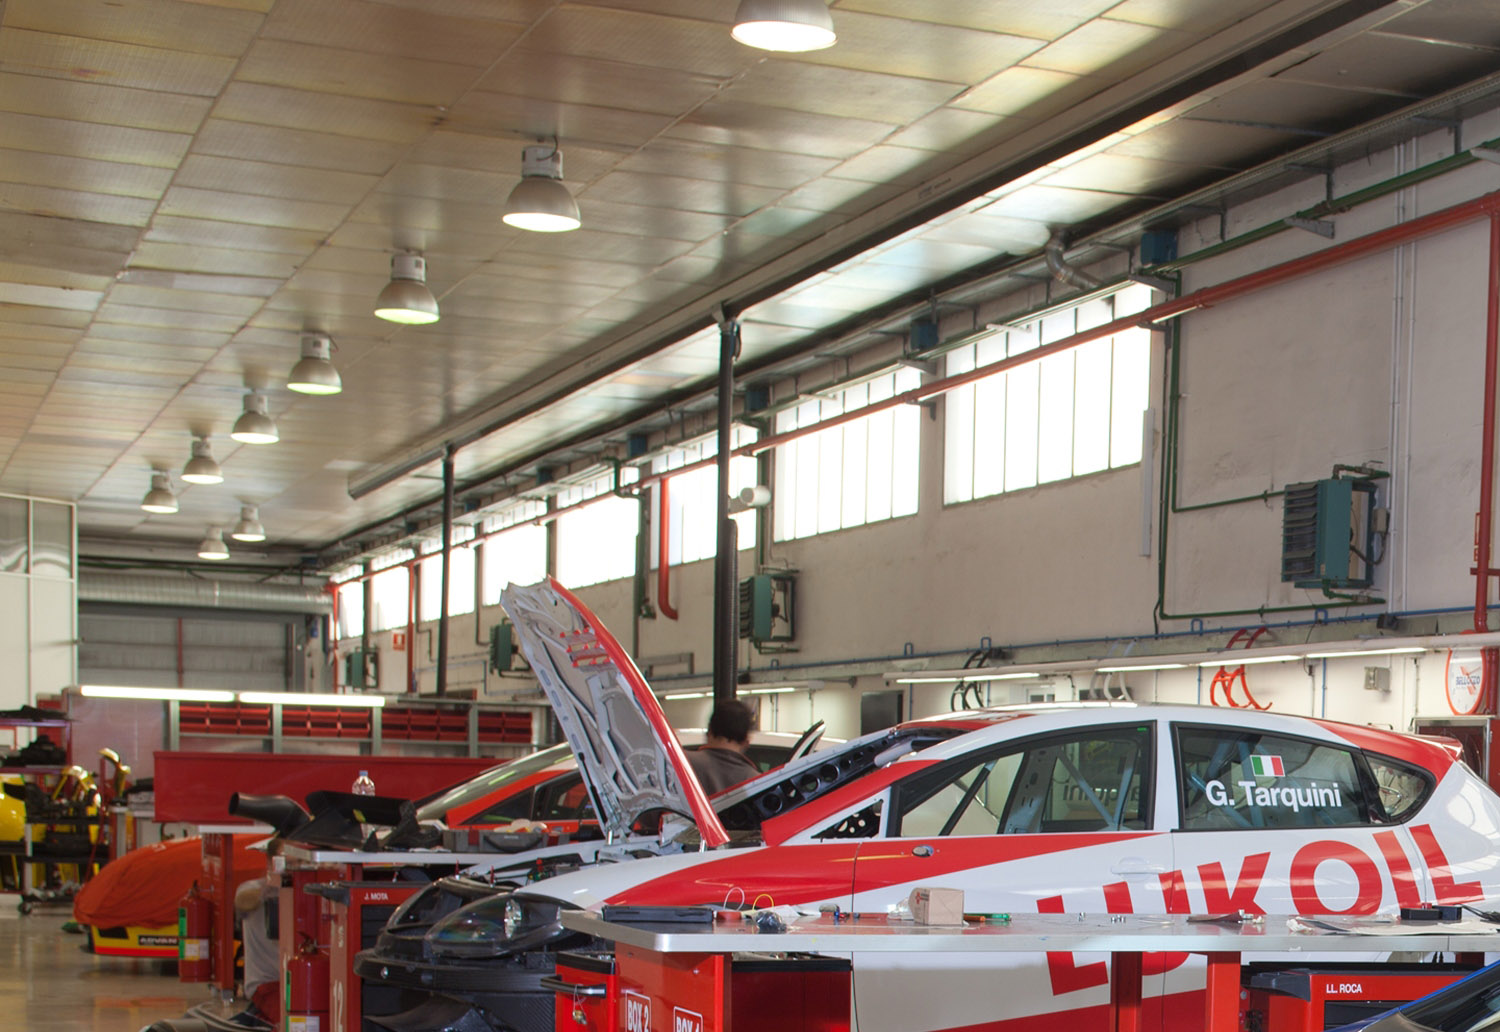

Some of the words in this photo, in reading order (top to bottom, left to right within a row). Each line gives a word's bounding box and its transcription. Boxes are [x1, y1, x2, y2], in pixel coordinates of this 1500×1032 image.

[1205, 780, 1235, 807] G.
[1238, 780, 1342, 813] Tarquini
[1326, 983, 1338, 994] LL.
[1339, 983, 1363, 994] ROCA
